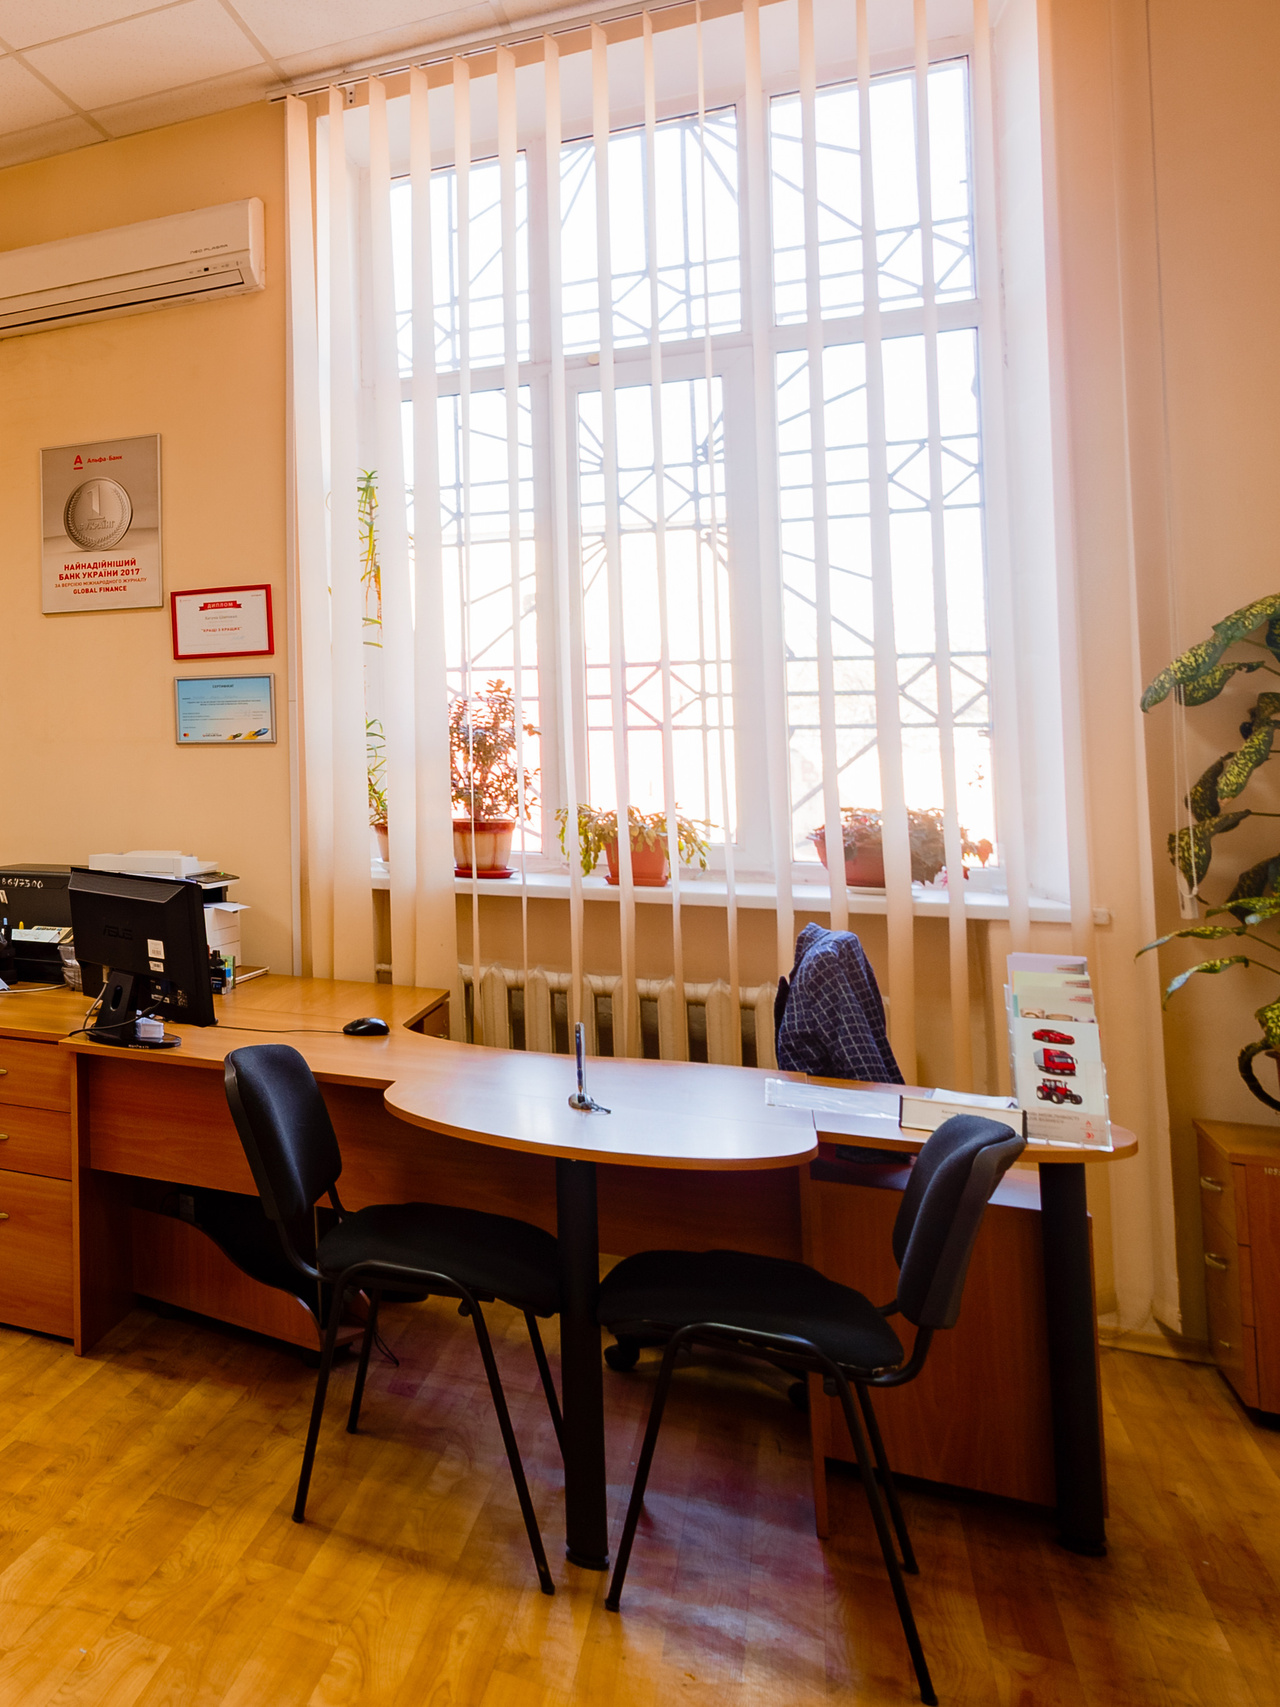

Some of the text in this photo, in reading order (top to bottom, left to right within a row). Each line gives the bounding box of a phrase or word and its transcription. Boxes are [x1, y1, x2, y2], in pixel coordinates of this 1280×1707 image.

[64, 557, 136, 571] НАЙНАДІЙНІШИЙ
[58, 567, 140, 581] БАНК УКРАЇНИ 2017
[73, 585, 127, 595] GLOBAL FINANCE
[103, 924, 134, 941] ASUS
